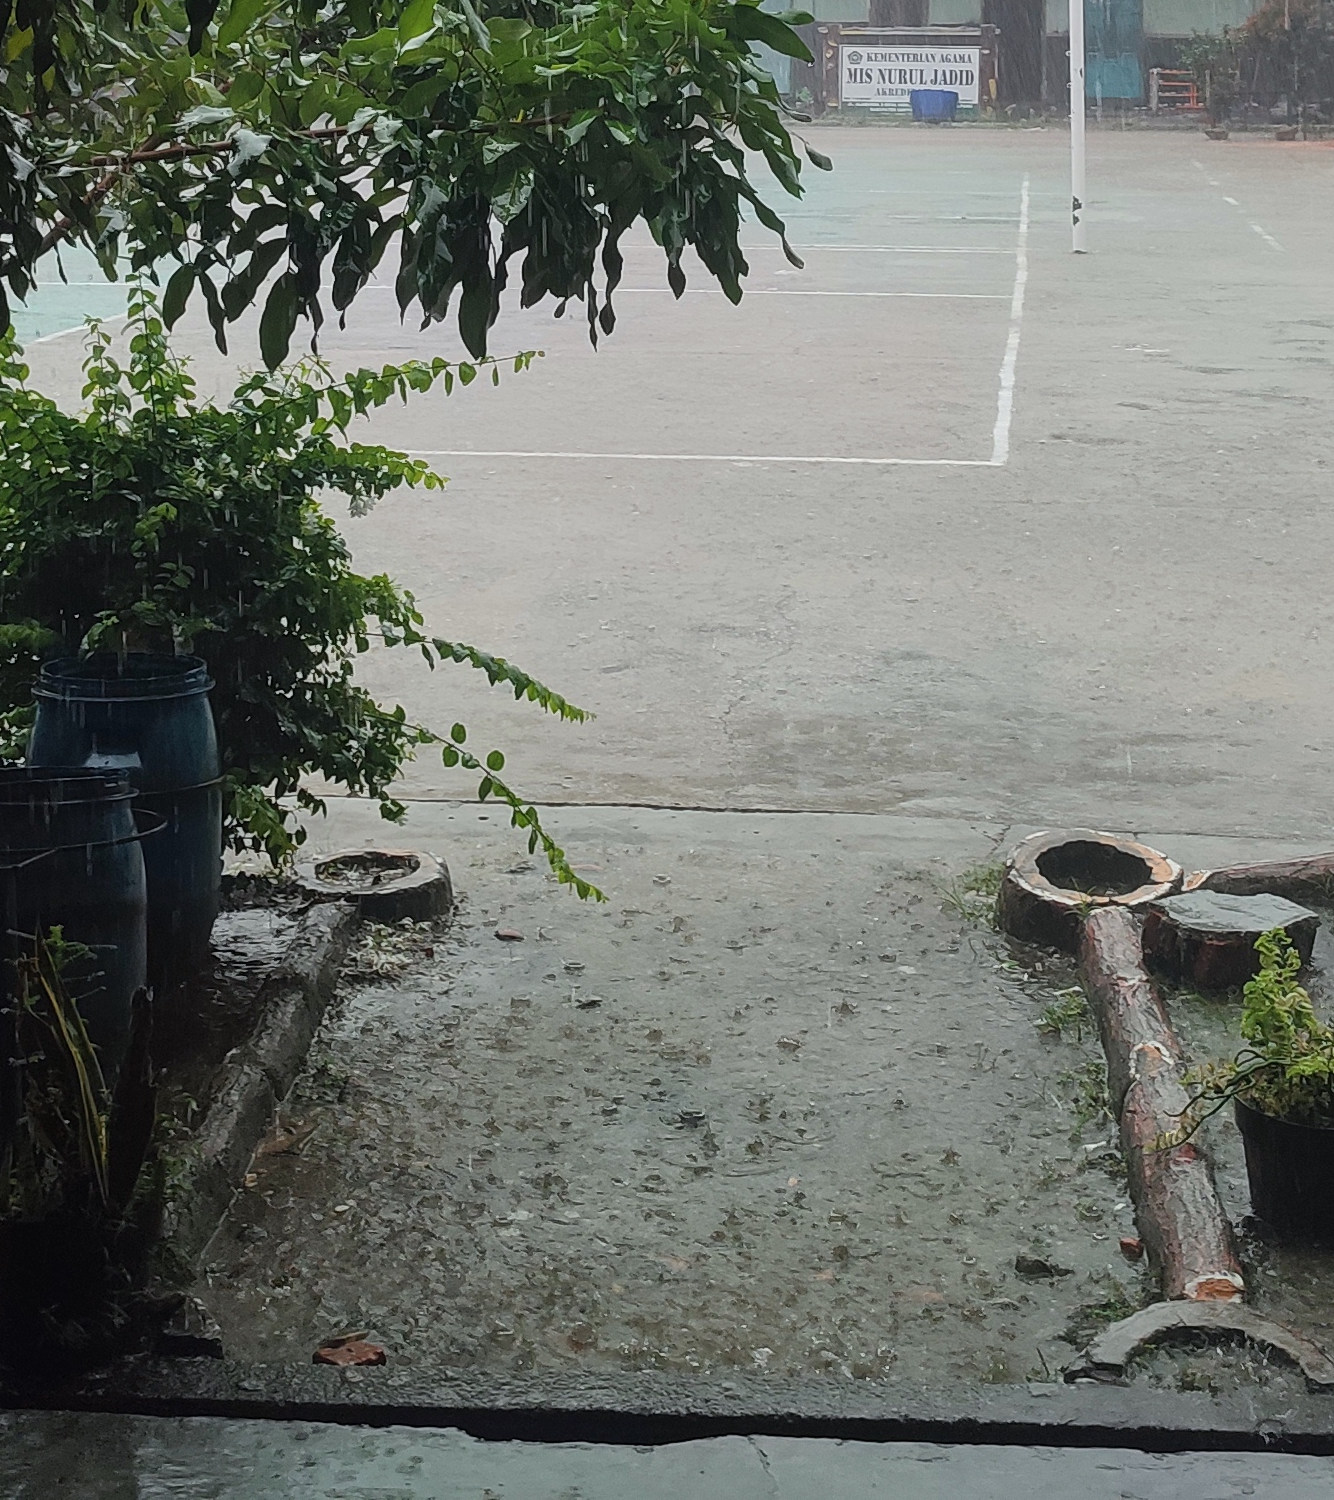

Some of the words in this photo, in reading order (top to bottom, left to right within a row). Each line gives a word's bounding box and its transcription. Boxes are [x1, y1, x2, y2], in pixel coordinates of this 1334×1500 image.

[866, 52, 936, 63] KEMENTERIAN
[938, 53, 972, 64] AGAMA
[846, 67, 873, 85] MIS
[877, 68, 928, 86] NURUL
[930, 68, 975, 86] JADID
